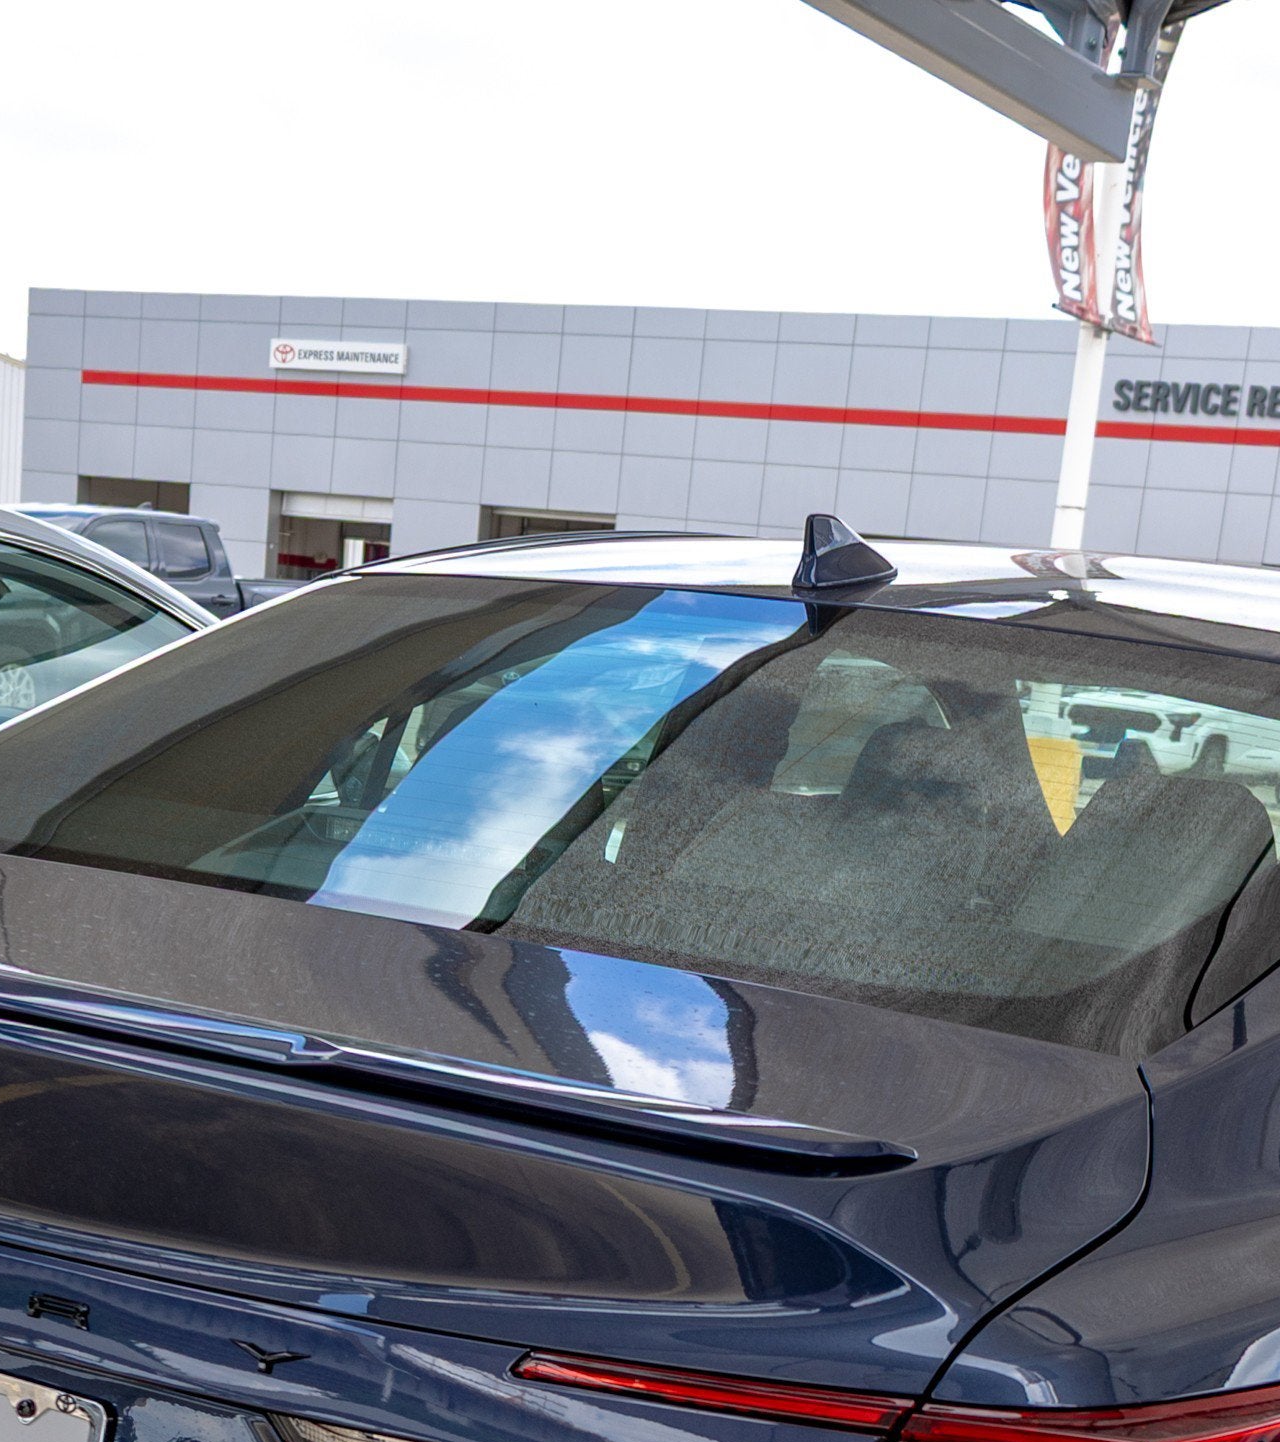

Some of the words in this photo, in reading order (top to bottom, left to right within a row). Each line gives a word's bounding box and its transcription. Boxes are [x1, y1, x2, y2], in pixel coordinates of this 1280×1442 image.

[1060, 212, 1082, 301] New
[297, 349, 334, 361] EXPRESS
[336, 351, 399, 364] MAINTENANCE
[1112, 378, 1240, 417] SERVICE
